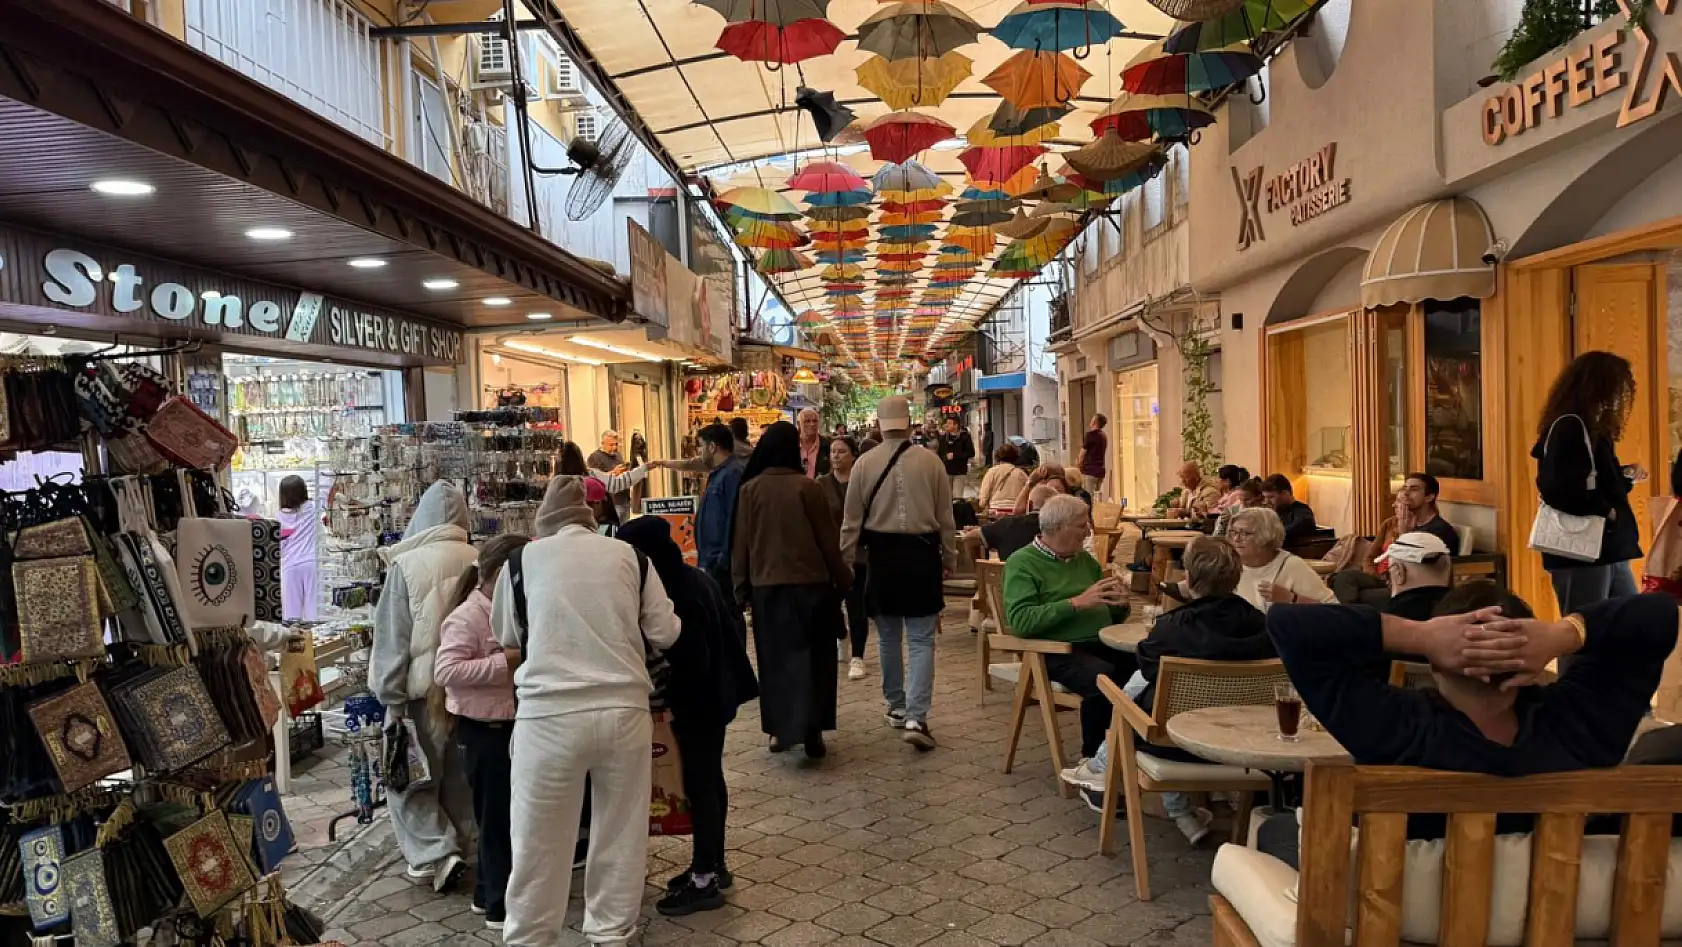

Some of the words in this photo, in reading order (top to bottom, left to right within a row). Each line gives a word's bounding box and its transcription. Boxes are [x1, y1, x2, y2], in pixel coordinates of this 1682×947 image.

[1482, 29, 1625, 146] COFFEE
[1265, 141, 1337, 213] FACTORY
[1290, 178, 1352, 226] PATISSERIE
[43, 249, 281, 332] Stone
[331, 306, 385, 350] SILVER
[387, 317, 398, 351] &
[400, 321, 427, 356] GIFT
[431, 327, 461, 360] SHOP
[941, 405, 962, 414] FLO
